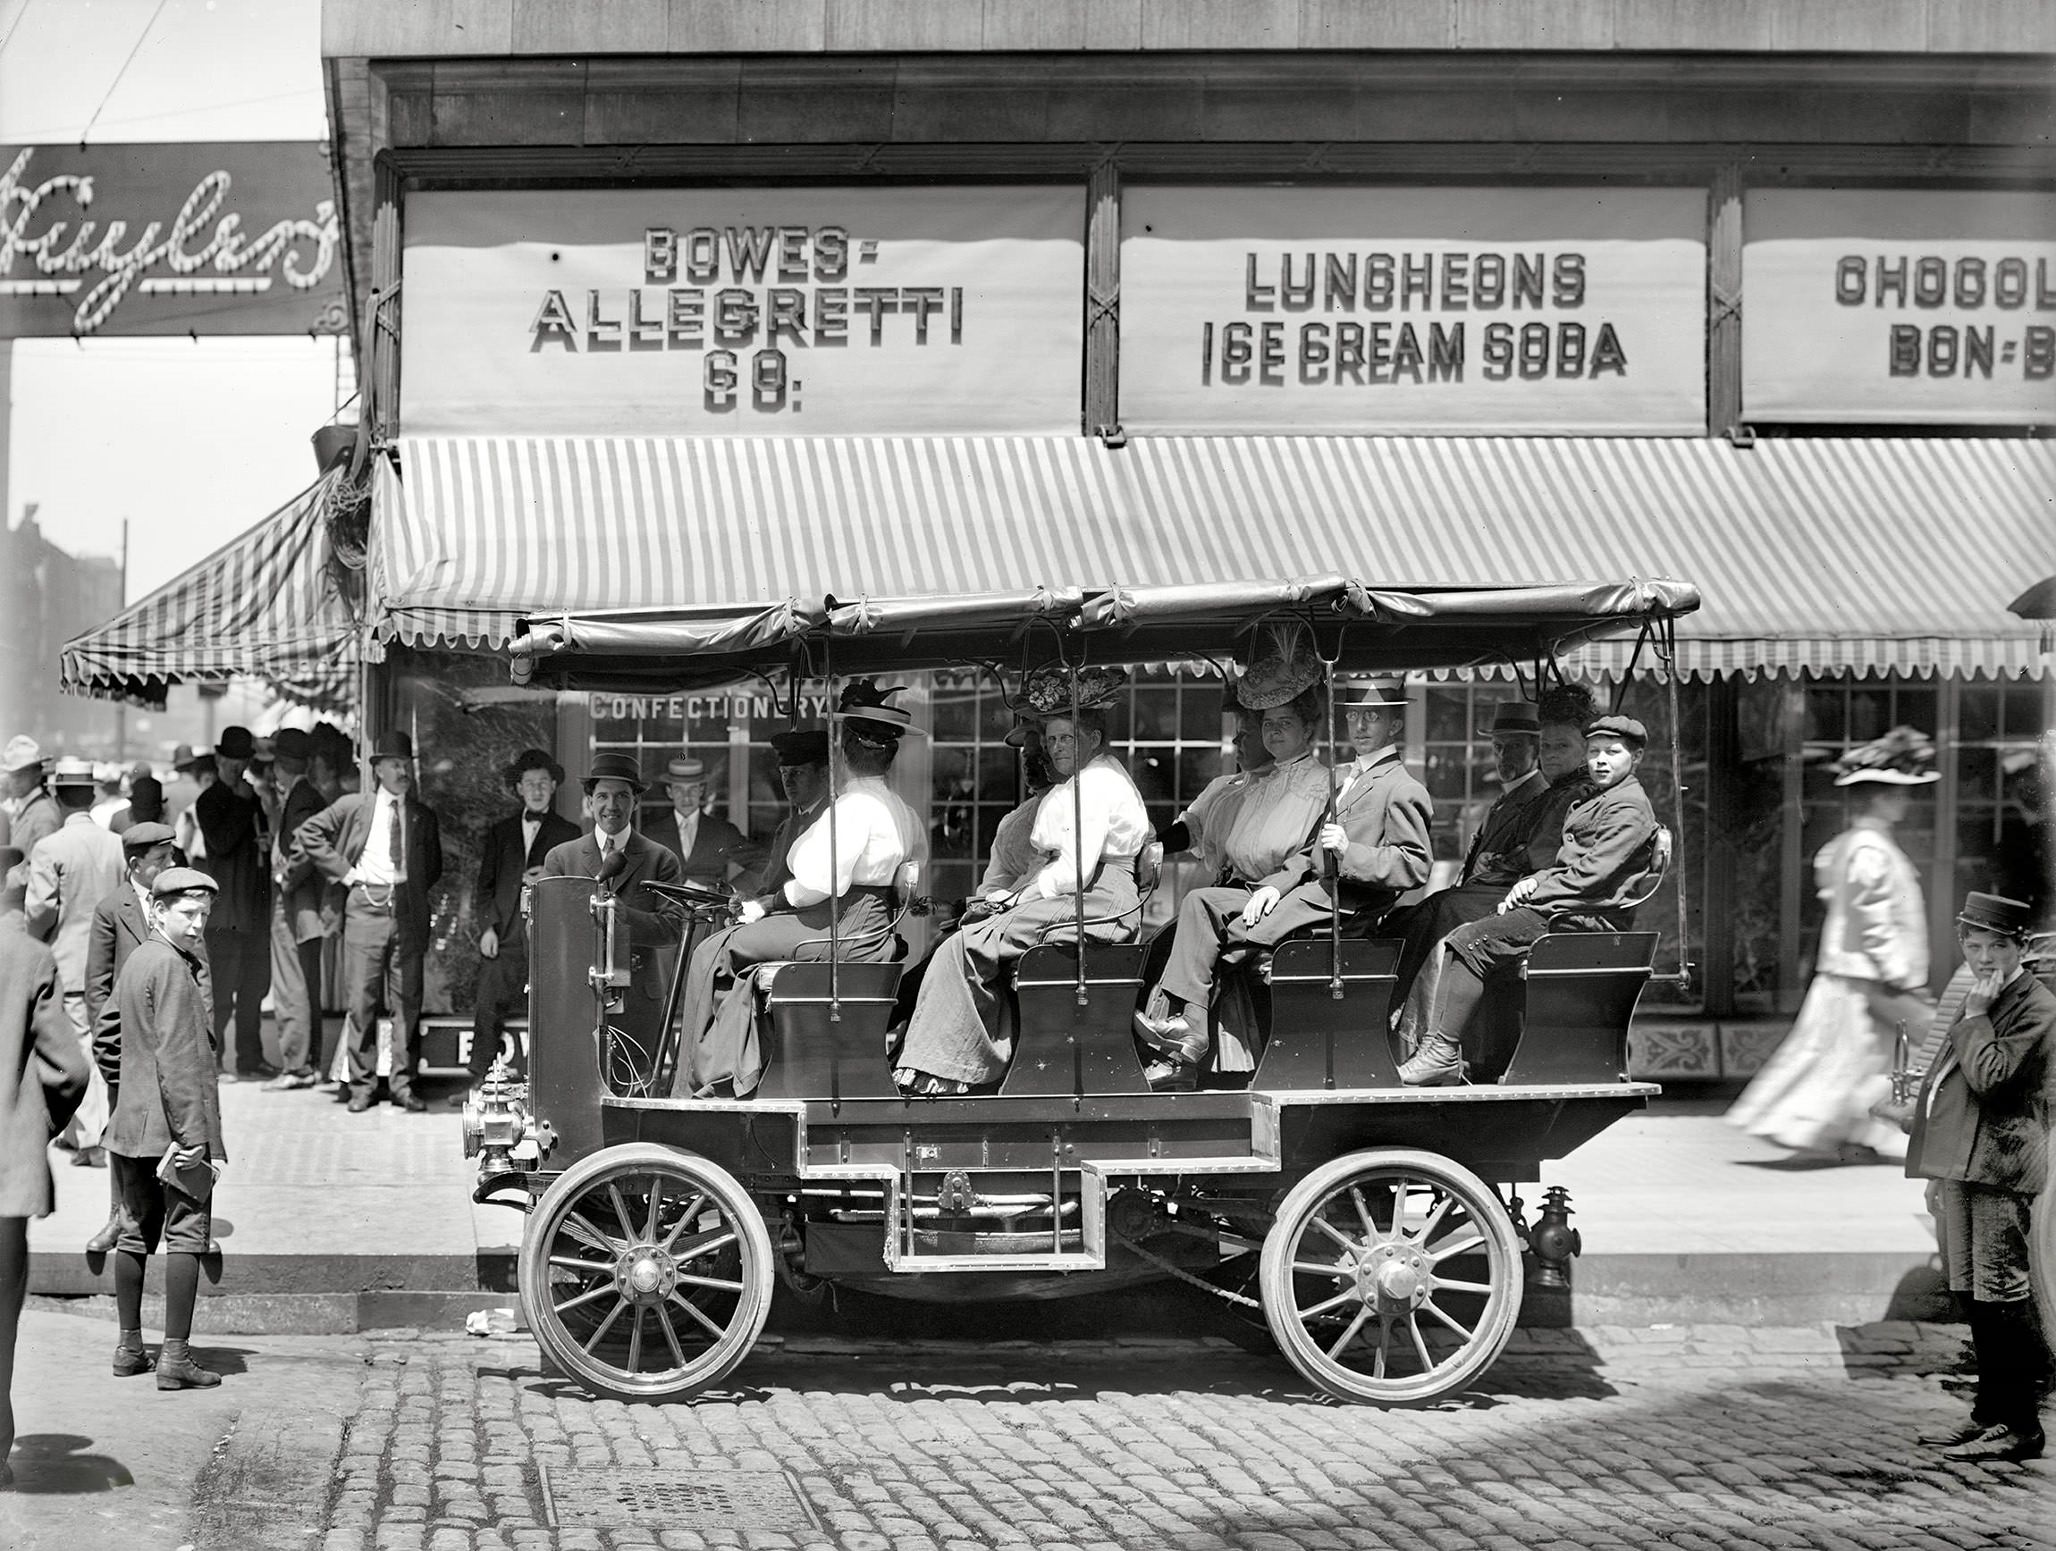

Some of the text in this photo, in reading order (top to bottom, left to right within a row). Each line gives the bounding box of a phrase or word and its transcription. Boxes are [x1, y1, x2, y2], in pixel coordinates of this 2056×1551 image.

[645, 226, 879, 279] BOWES-
[1245, 252, 1587, 304] LUNCHEONS
[1836, 255, 2056, 309] CHOCOL
[529, 287, 964, 342] ALLEGRETTI
[704, 349, 802, 402] CO.
[1202, 322, 1627, 376] ICE CREAM SODA
[590, 696, 826, 719] CONFECTIONERY
